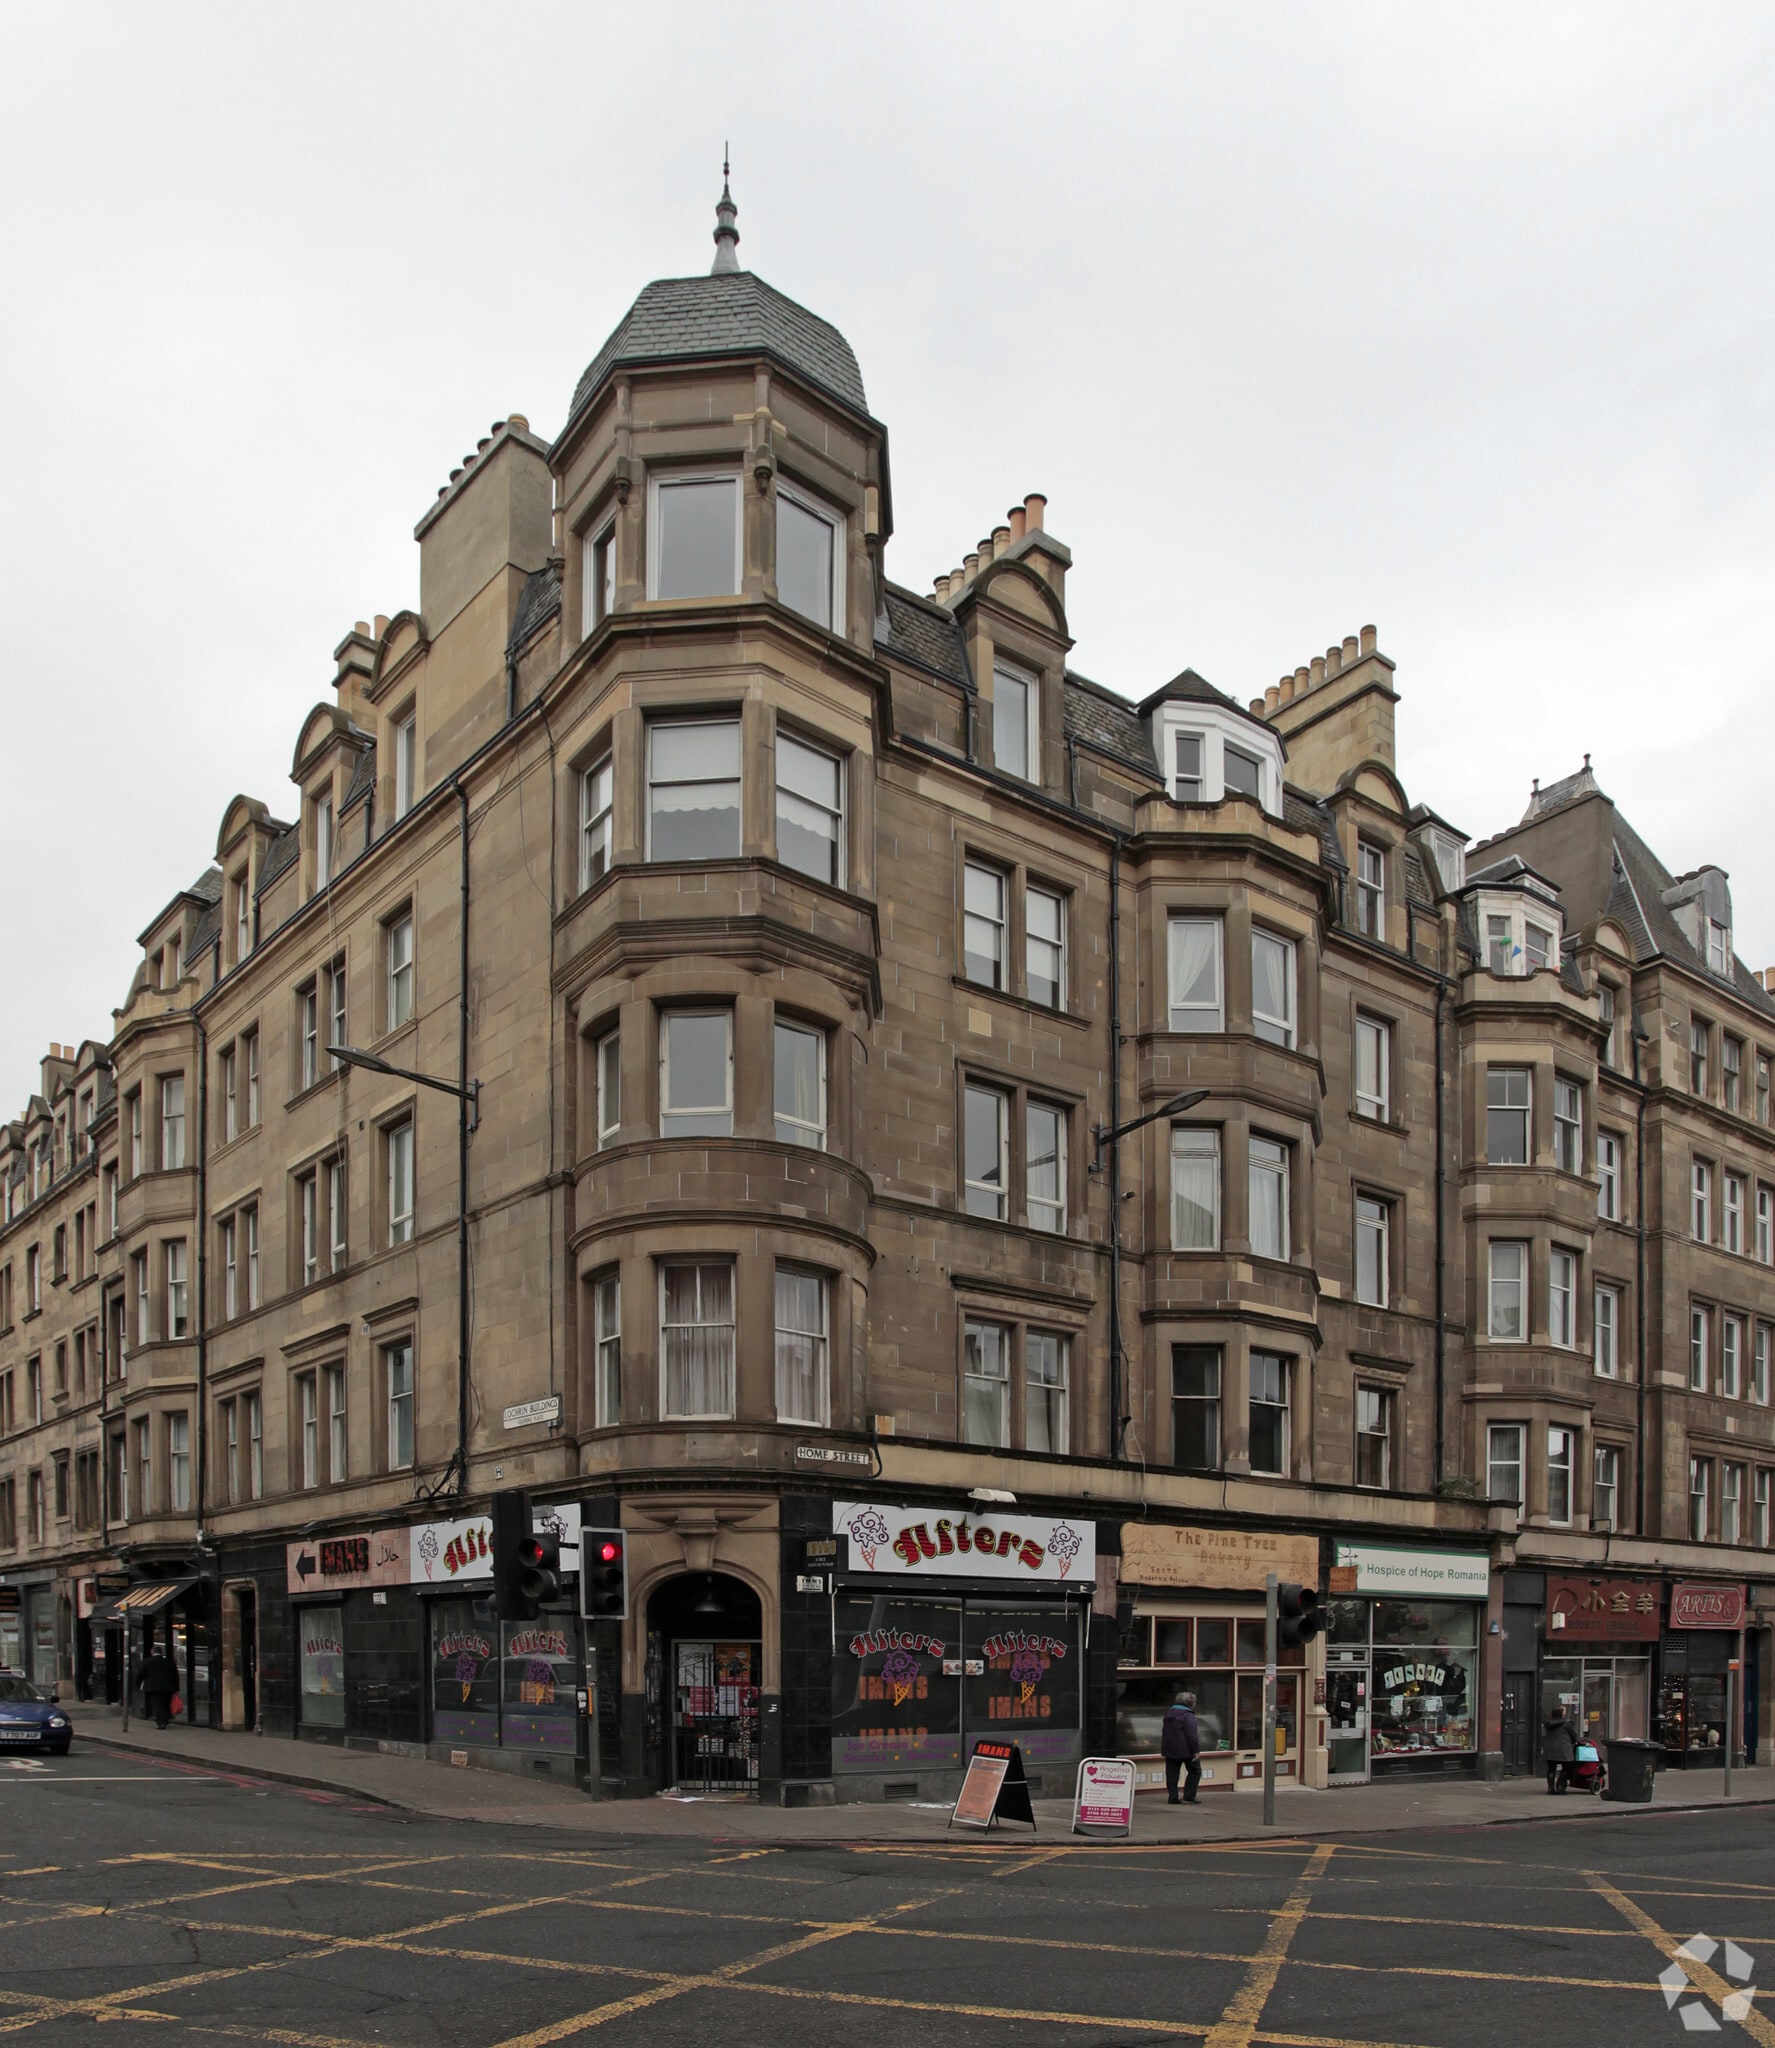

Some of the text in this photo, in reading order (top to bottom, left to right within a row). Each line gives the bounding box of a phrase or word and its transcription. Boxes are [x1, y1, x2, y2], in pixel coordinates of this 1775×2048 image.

[505, 1399, 558, 1419] LOCHRIN BUILDINGS
[799, 1447, 867, 1464] HOME STREET
[444, 1520, 496, 1577] Aft
[1174, 1530, 1277, 1551] The Pine Tree
[1200, 1550, 1252, 1570] Bakery
[1367, 1563, 1487, 1581] Hospice of Hope Romania
[988, 1694, 1052, 1720] IMANS
[847, 1740, 865, 1751] Ice
[869, 1740, 908, 1751] Cream
[977, 1743, 1012, 1758] IMANS
[1100, 1772, 1128, 1780] Flowers
